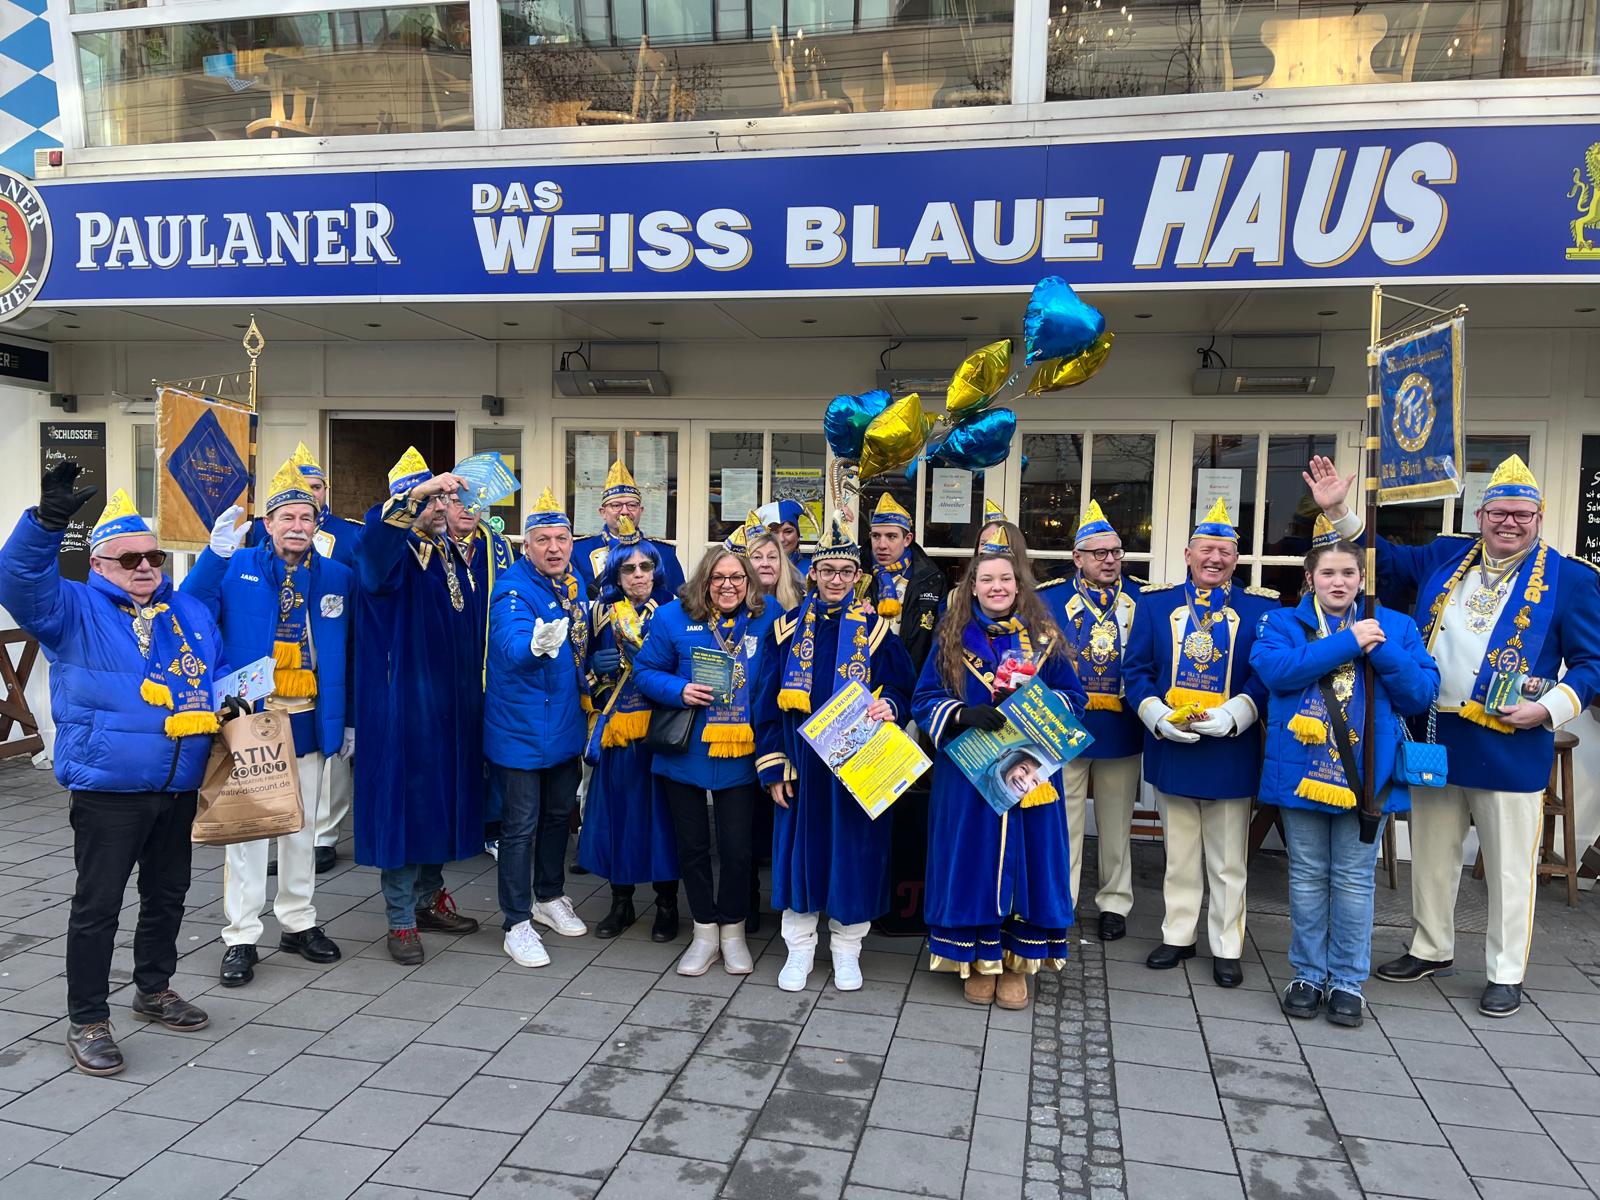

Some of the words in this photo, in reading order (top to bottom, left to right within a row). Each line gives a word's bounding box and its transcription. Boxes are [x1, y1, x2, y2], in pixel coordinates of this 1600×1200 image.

[472, 180, 563, 213] DAS
[472, 208, 753, 274] WEISS
[786, 196, 1104, 268] BLAUE
[1132, 141, 1457, 268] HAUS
[75, 202, 401, 271] PAULANER
[240, 573, 259, 583] JAKO
[686, 624, 704, 632] JAKO
